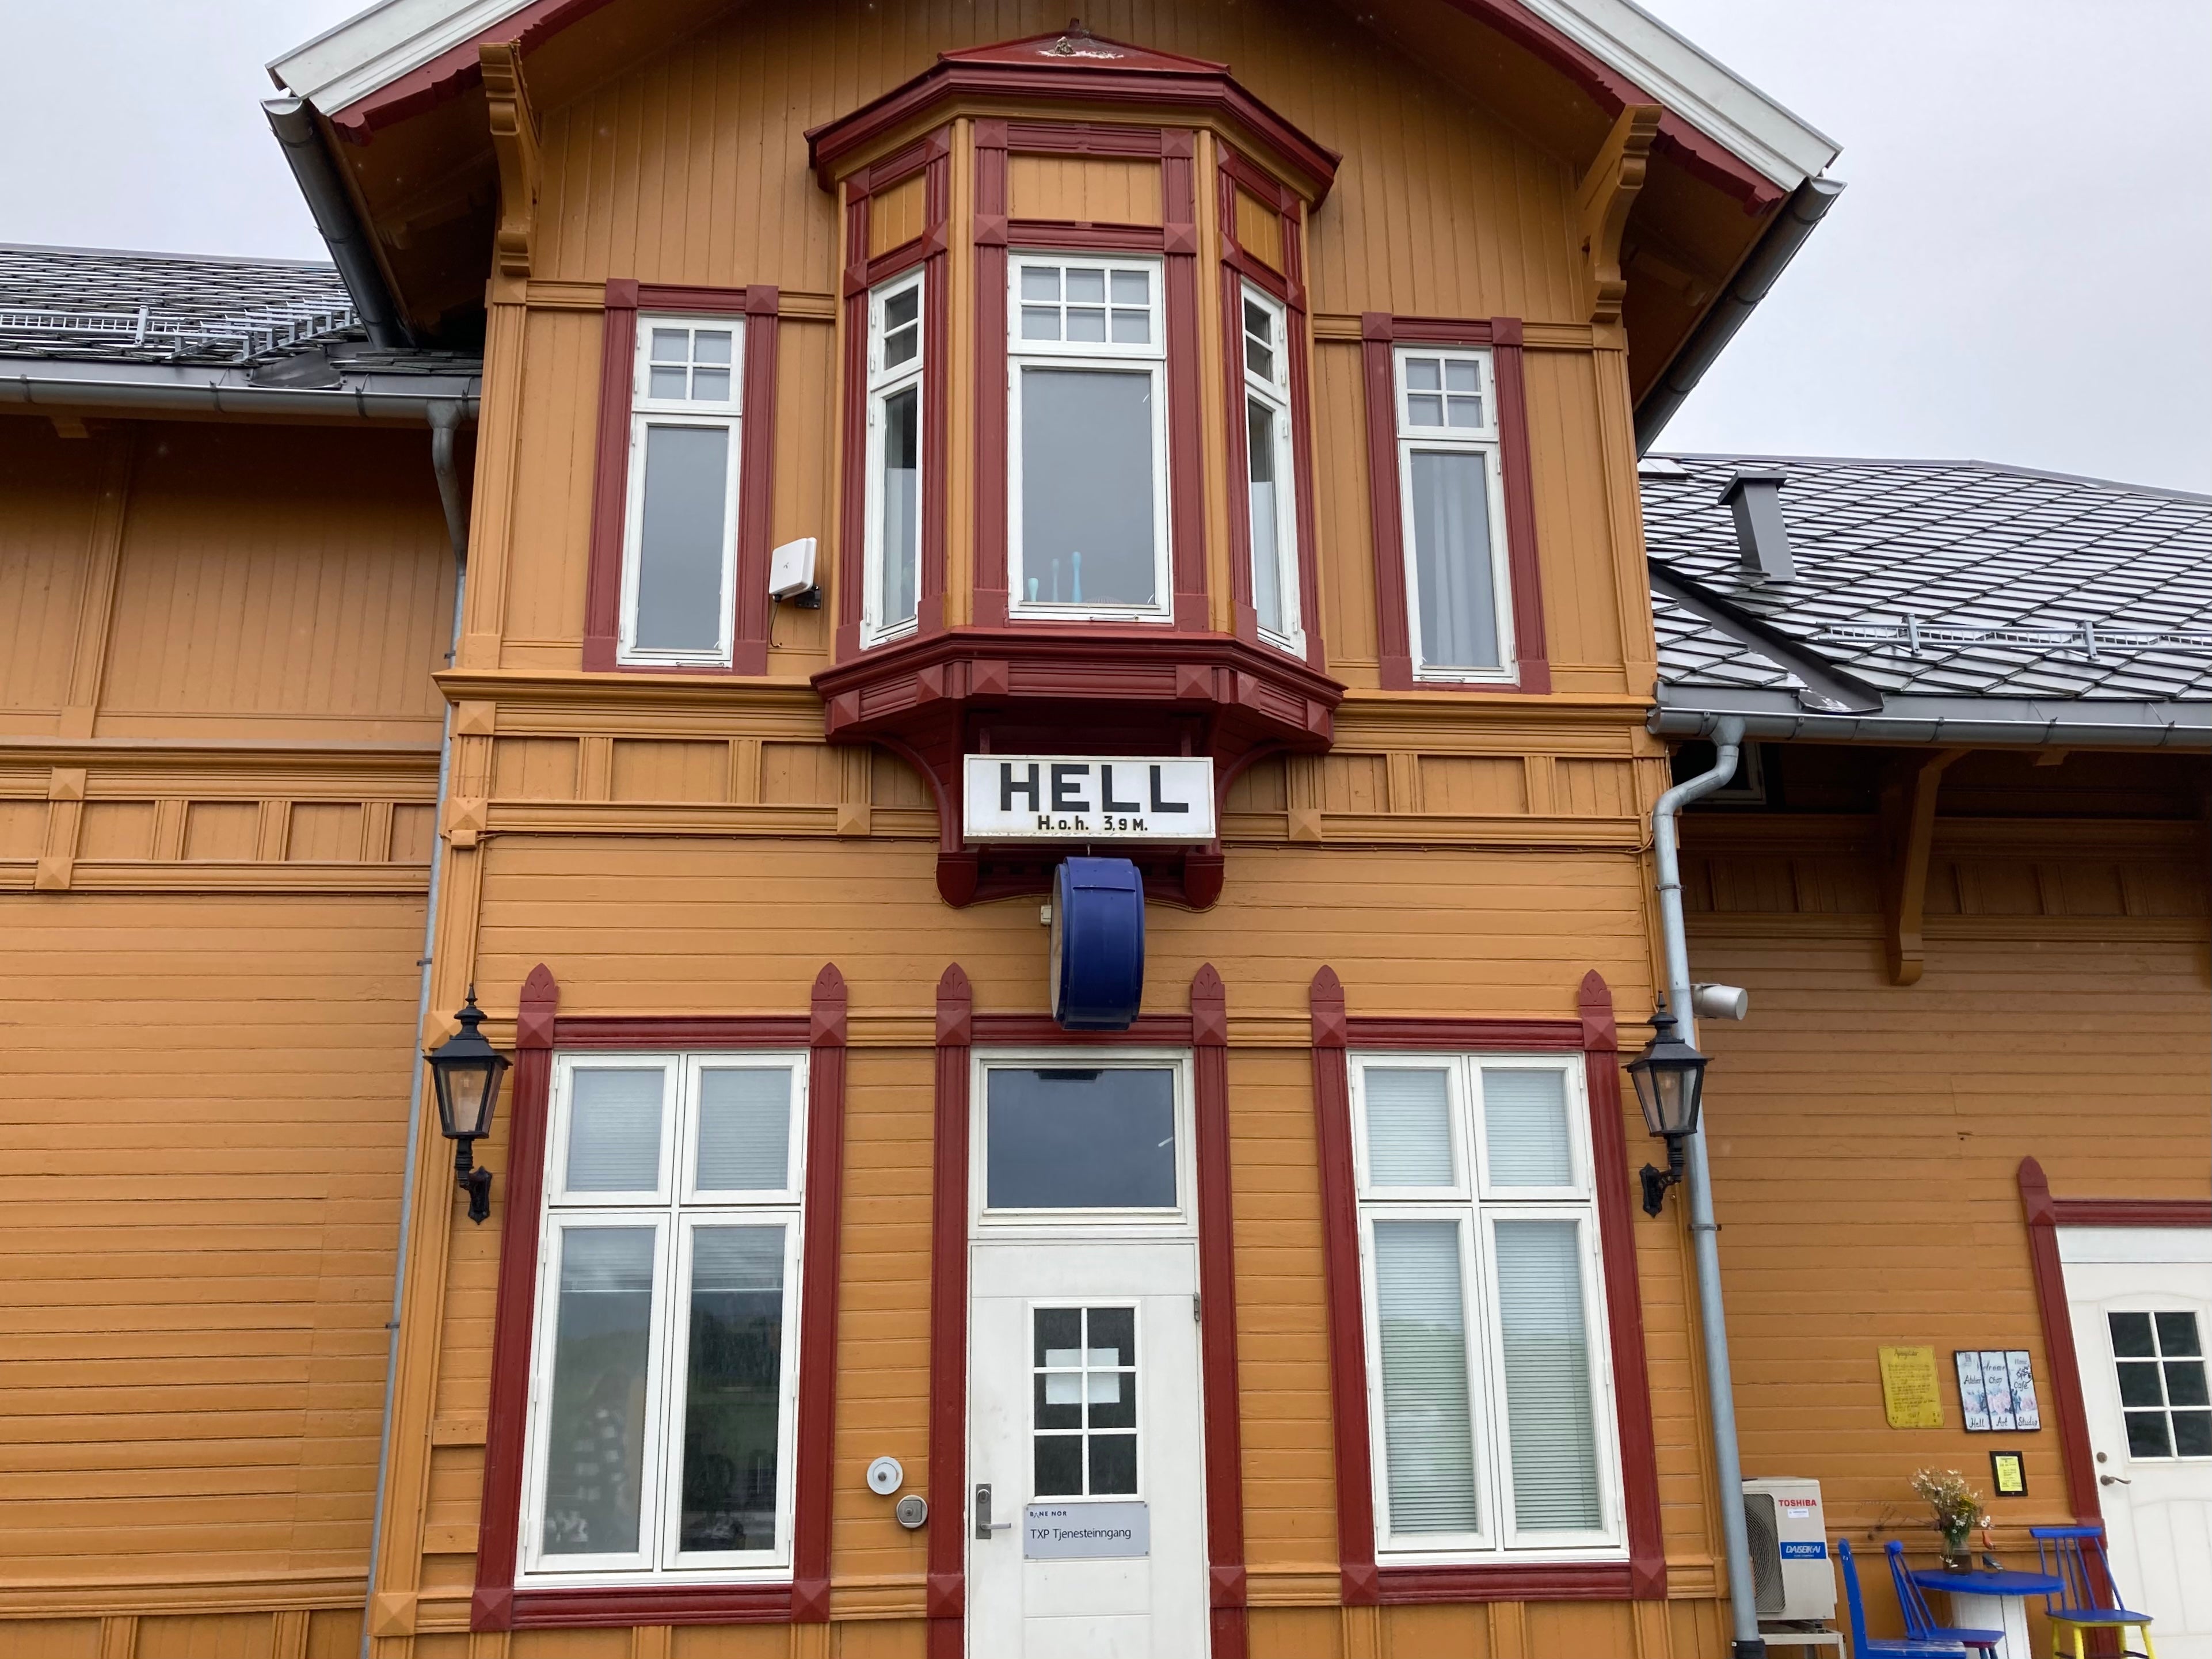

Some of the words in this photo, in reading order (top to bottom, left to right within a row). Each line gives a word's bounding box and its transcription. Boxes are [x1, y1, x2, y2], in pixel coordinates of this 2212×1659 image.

[1000, 763, 1189, 813] HELL
[1038, 815, 1089, 831] H.o.h.
[1103, 815, 1128, 832] 3,9
[1133, 819, 1148, 831] M.
[1969, 1417, 1985, 1428] Hell
[1996, 1416, 2008, 1426] Art
[2018, 1416, 2038, 1427] Studio
[1778, 1499, 1817, 1507] TOSHIBA
[1030, 1529, 1050, 1539] TXP
[1052, 1528, 1132, 1542] Tjenesteinngang
